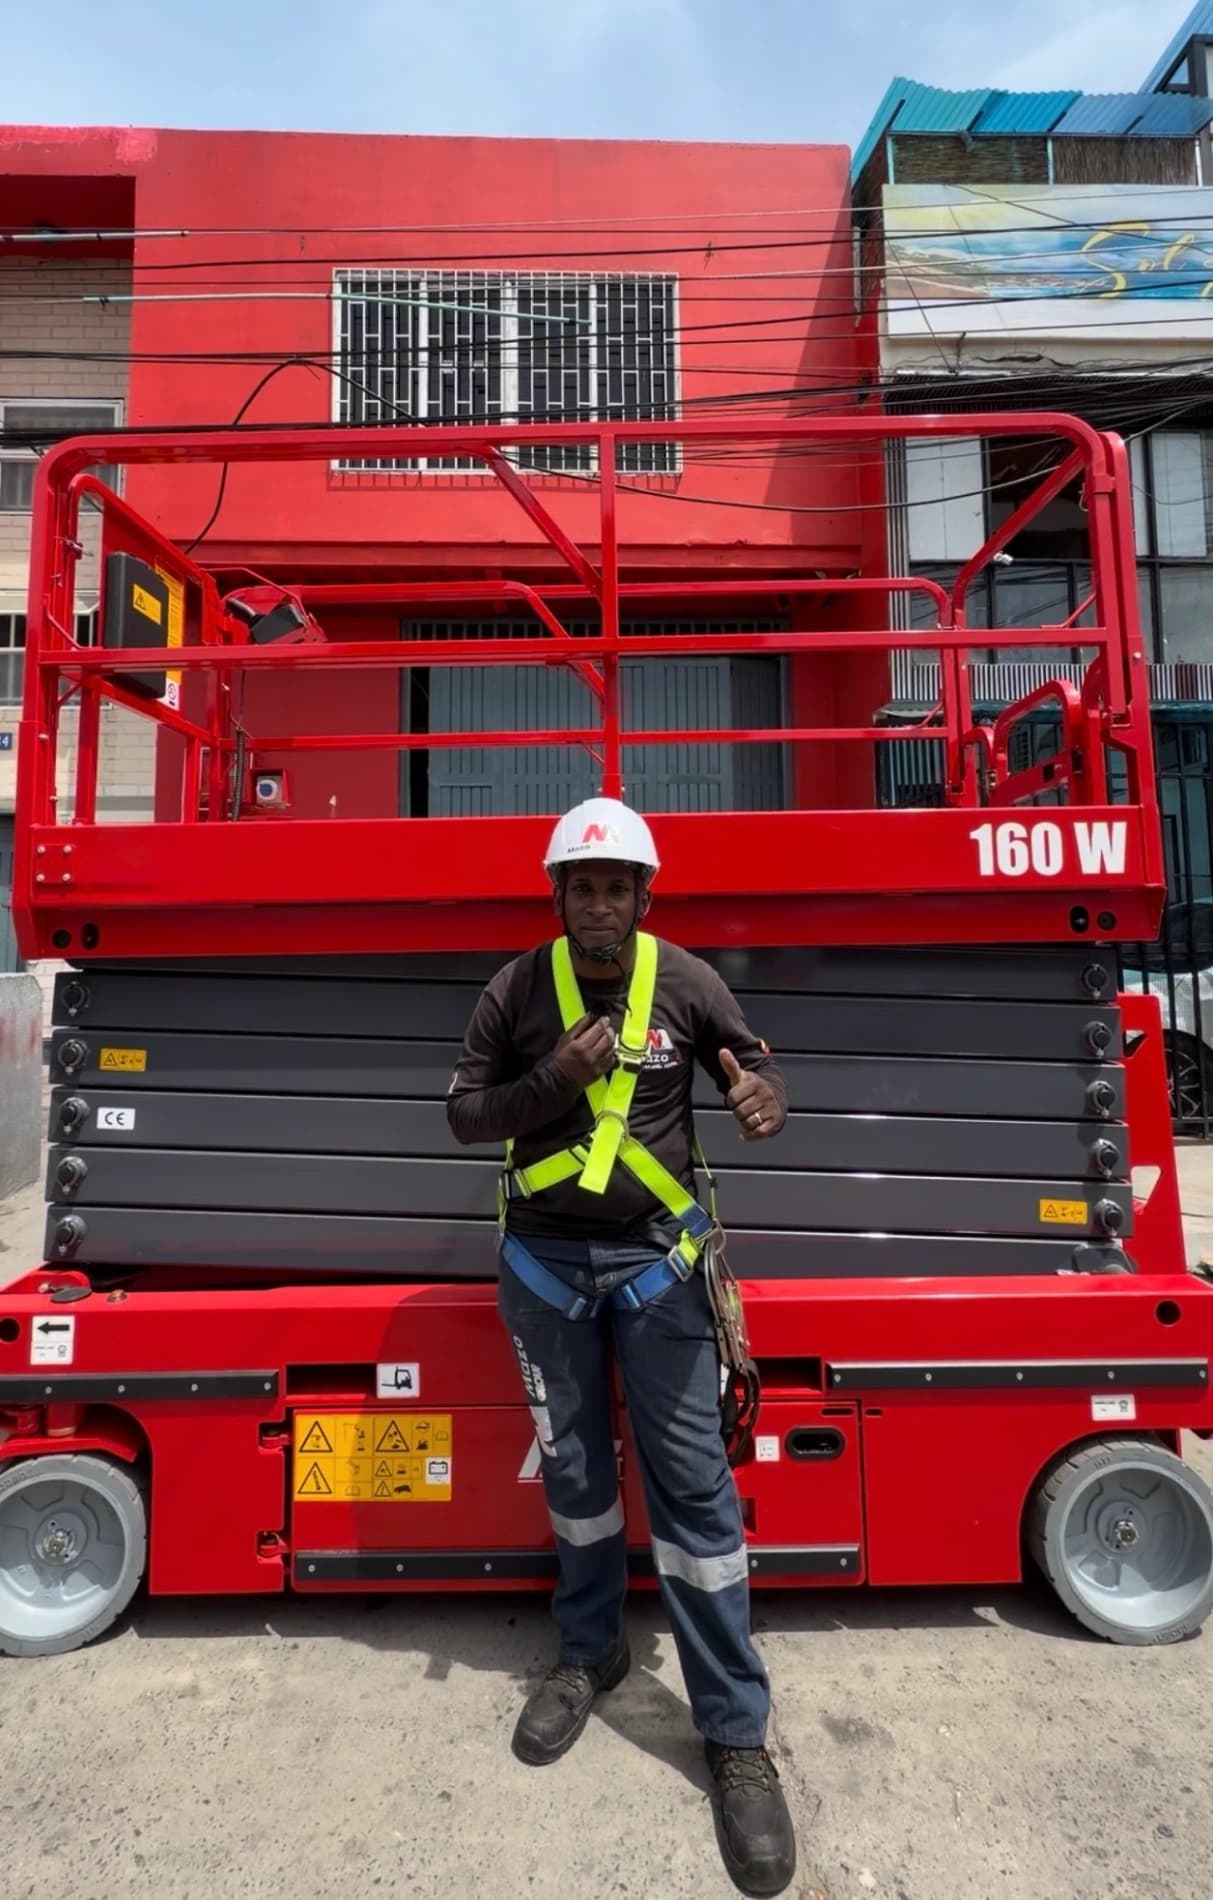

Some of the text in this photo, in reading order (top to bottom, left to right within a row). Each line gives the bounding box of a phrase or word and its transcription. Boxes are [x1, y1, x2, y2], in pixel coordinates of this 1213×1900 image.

[969, 820, 1128, 877] 160 W
[104, 1111, 125, 1126] CE
